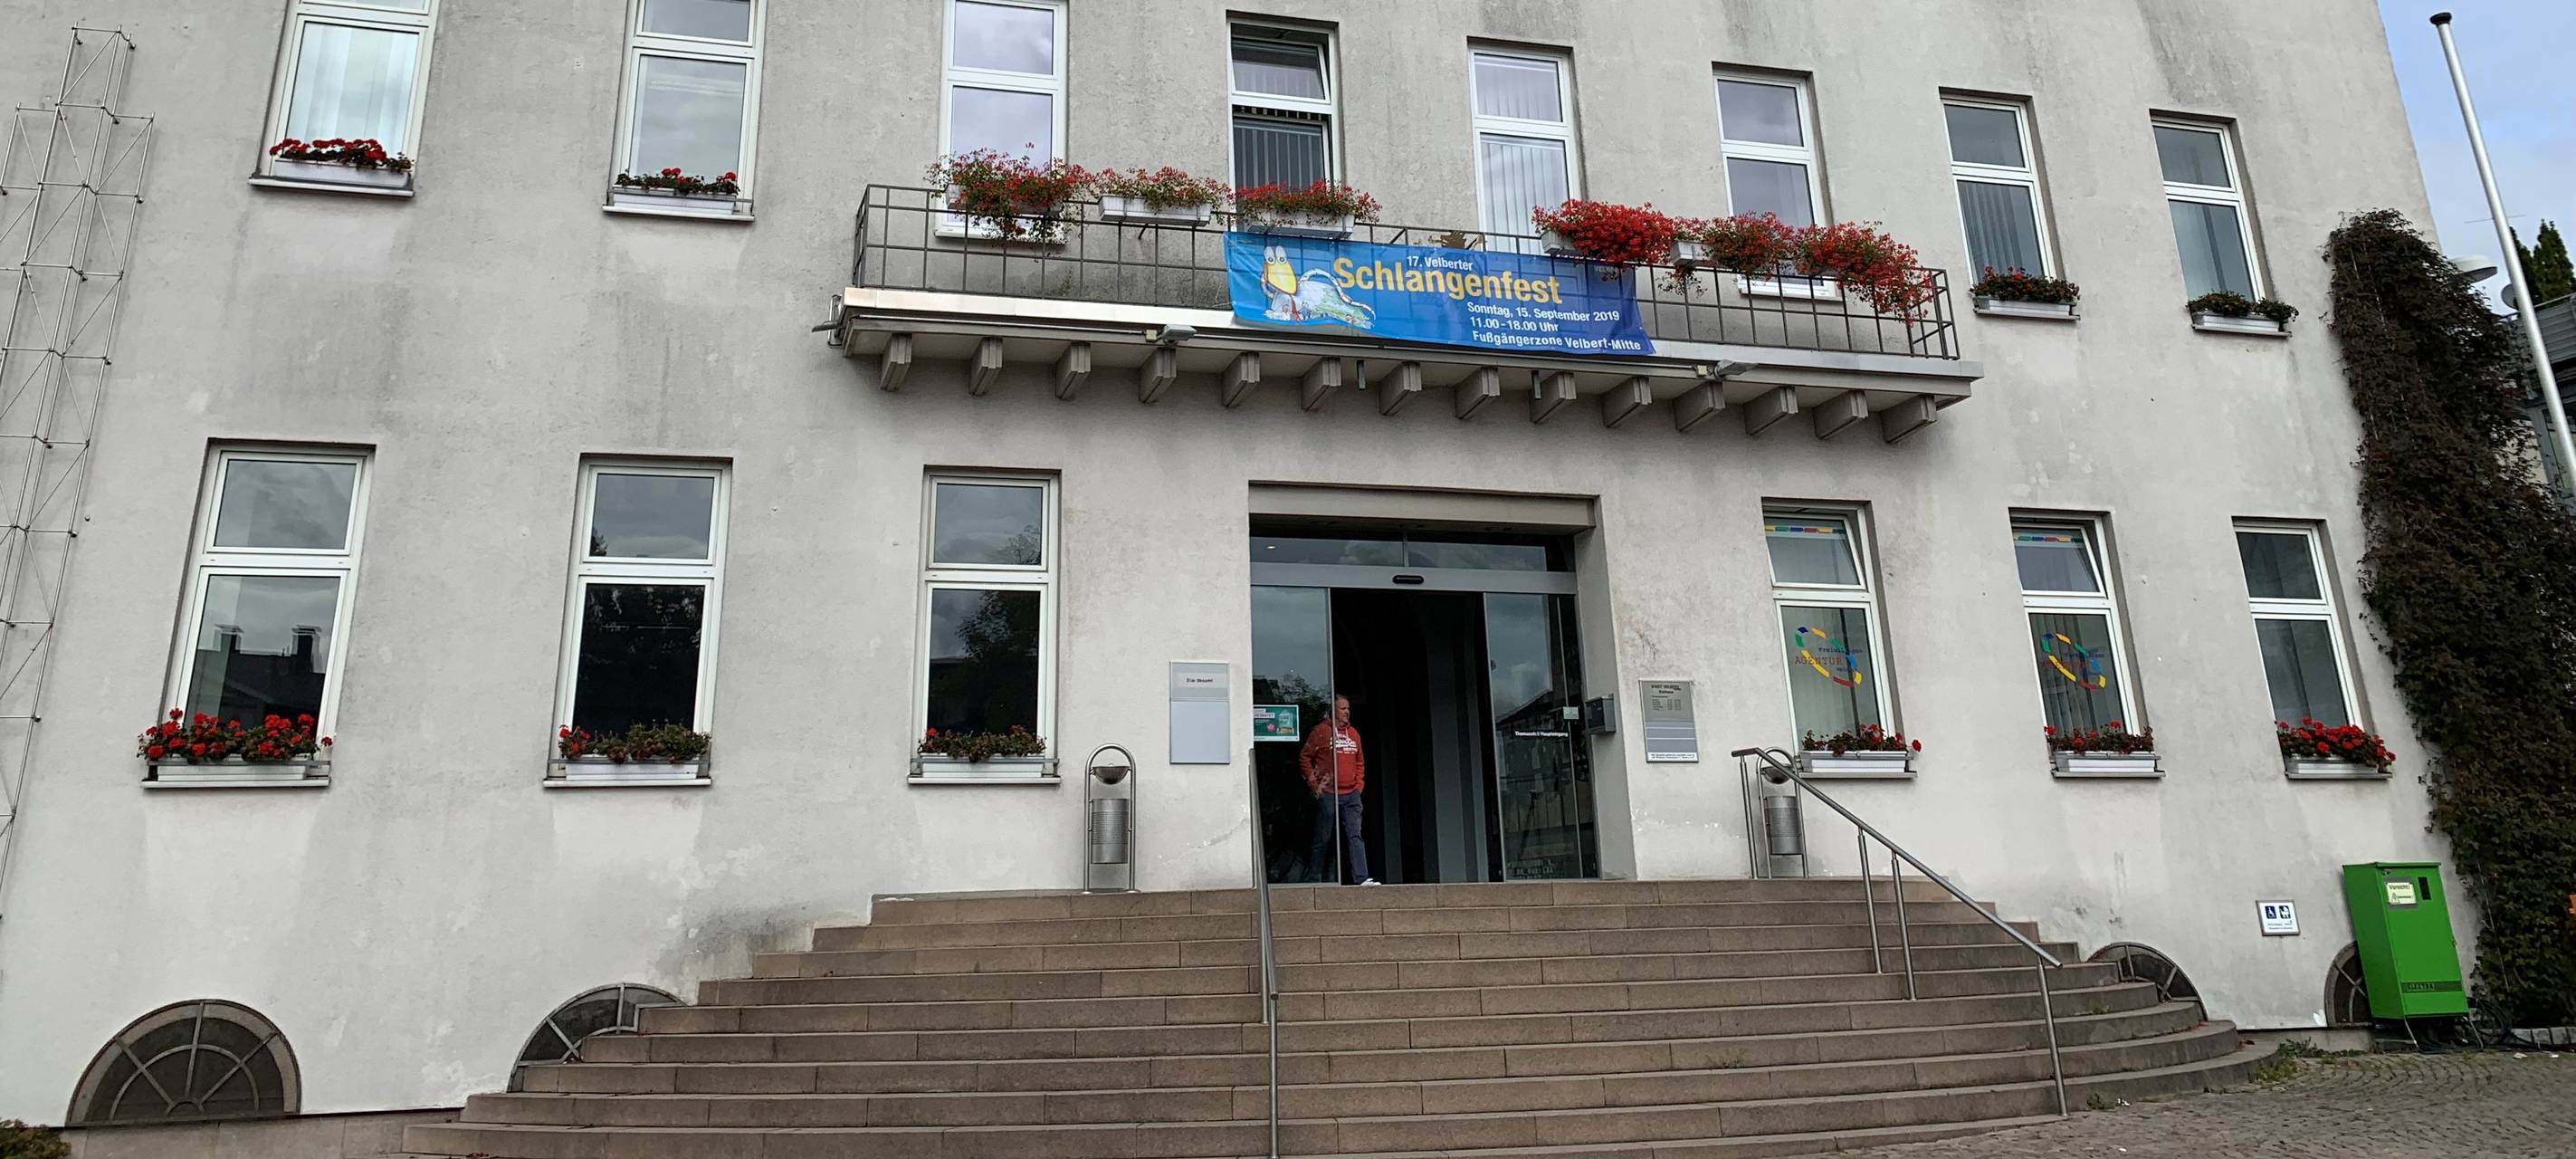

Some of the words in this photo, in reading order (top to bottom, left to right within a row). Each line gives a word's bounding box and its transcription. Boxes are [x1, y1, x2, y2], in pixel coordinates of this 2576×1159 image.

[1407, 256, 1422, 267] 17.
[1424, 257, 1473, 271] Velberter
[1333, 256, 1563, 304] Schlangenfest
[1467, 302, 1513, 318] Sonntag,
[1516, 307, 1531, 318] 15.
[1534, 309, 1590, 322] September
[1594, 311, 1619, 321] 2019
[1540, 321, 1559, 331] Uhr
[1473, 330, 1563, 346] Fußgängerzone
[1566, 337, 1641, 350] Velbert-Mitte
